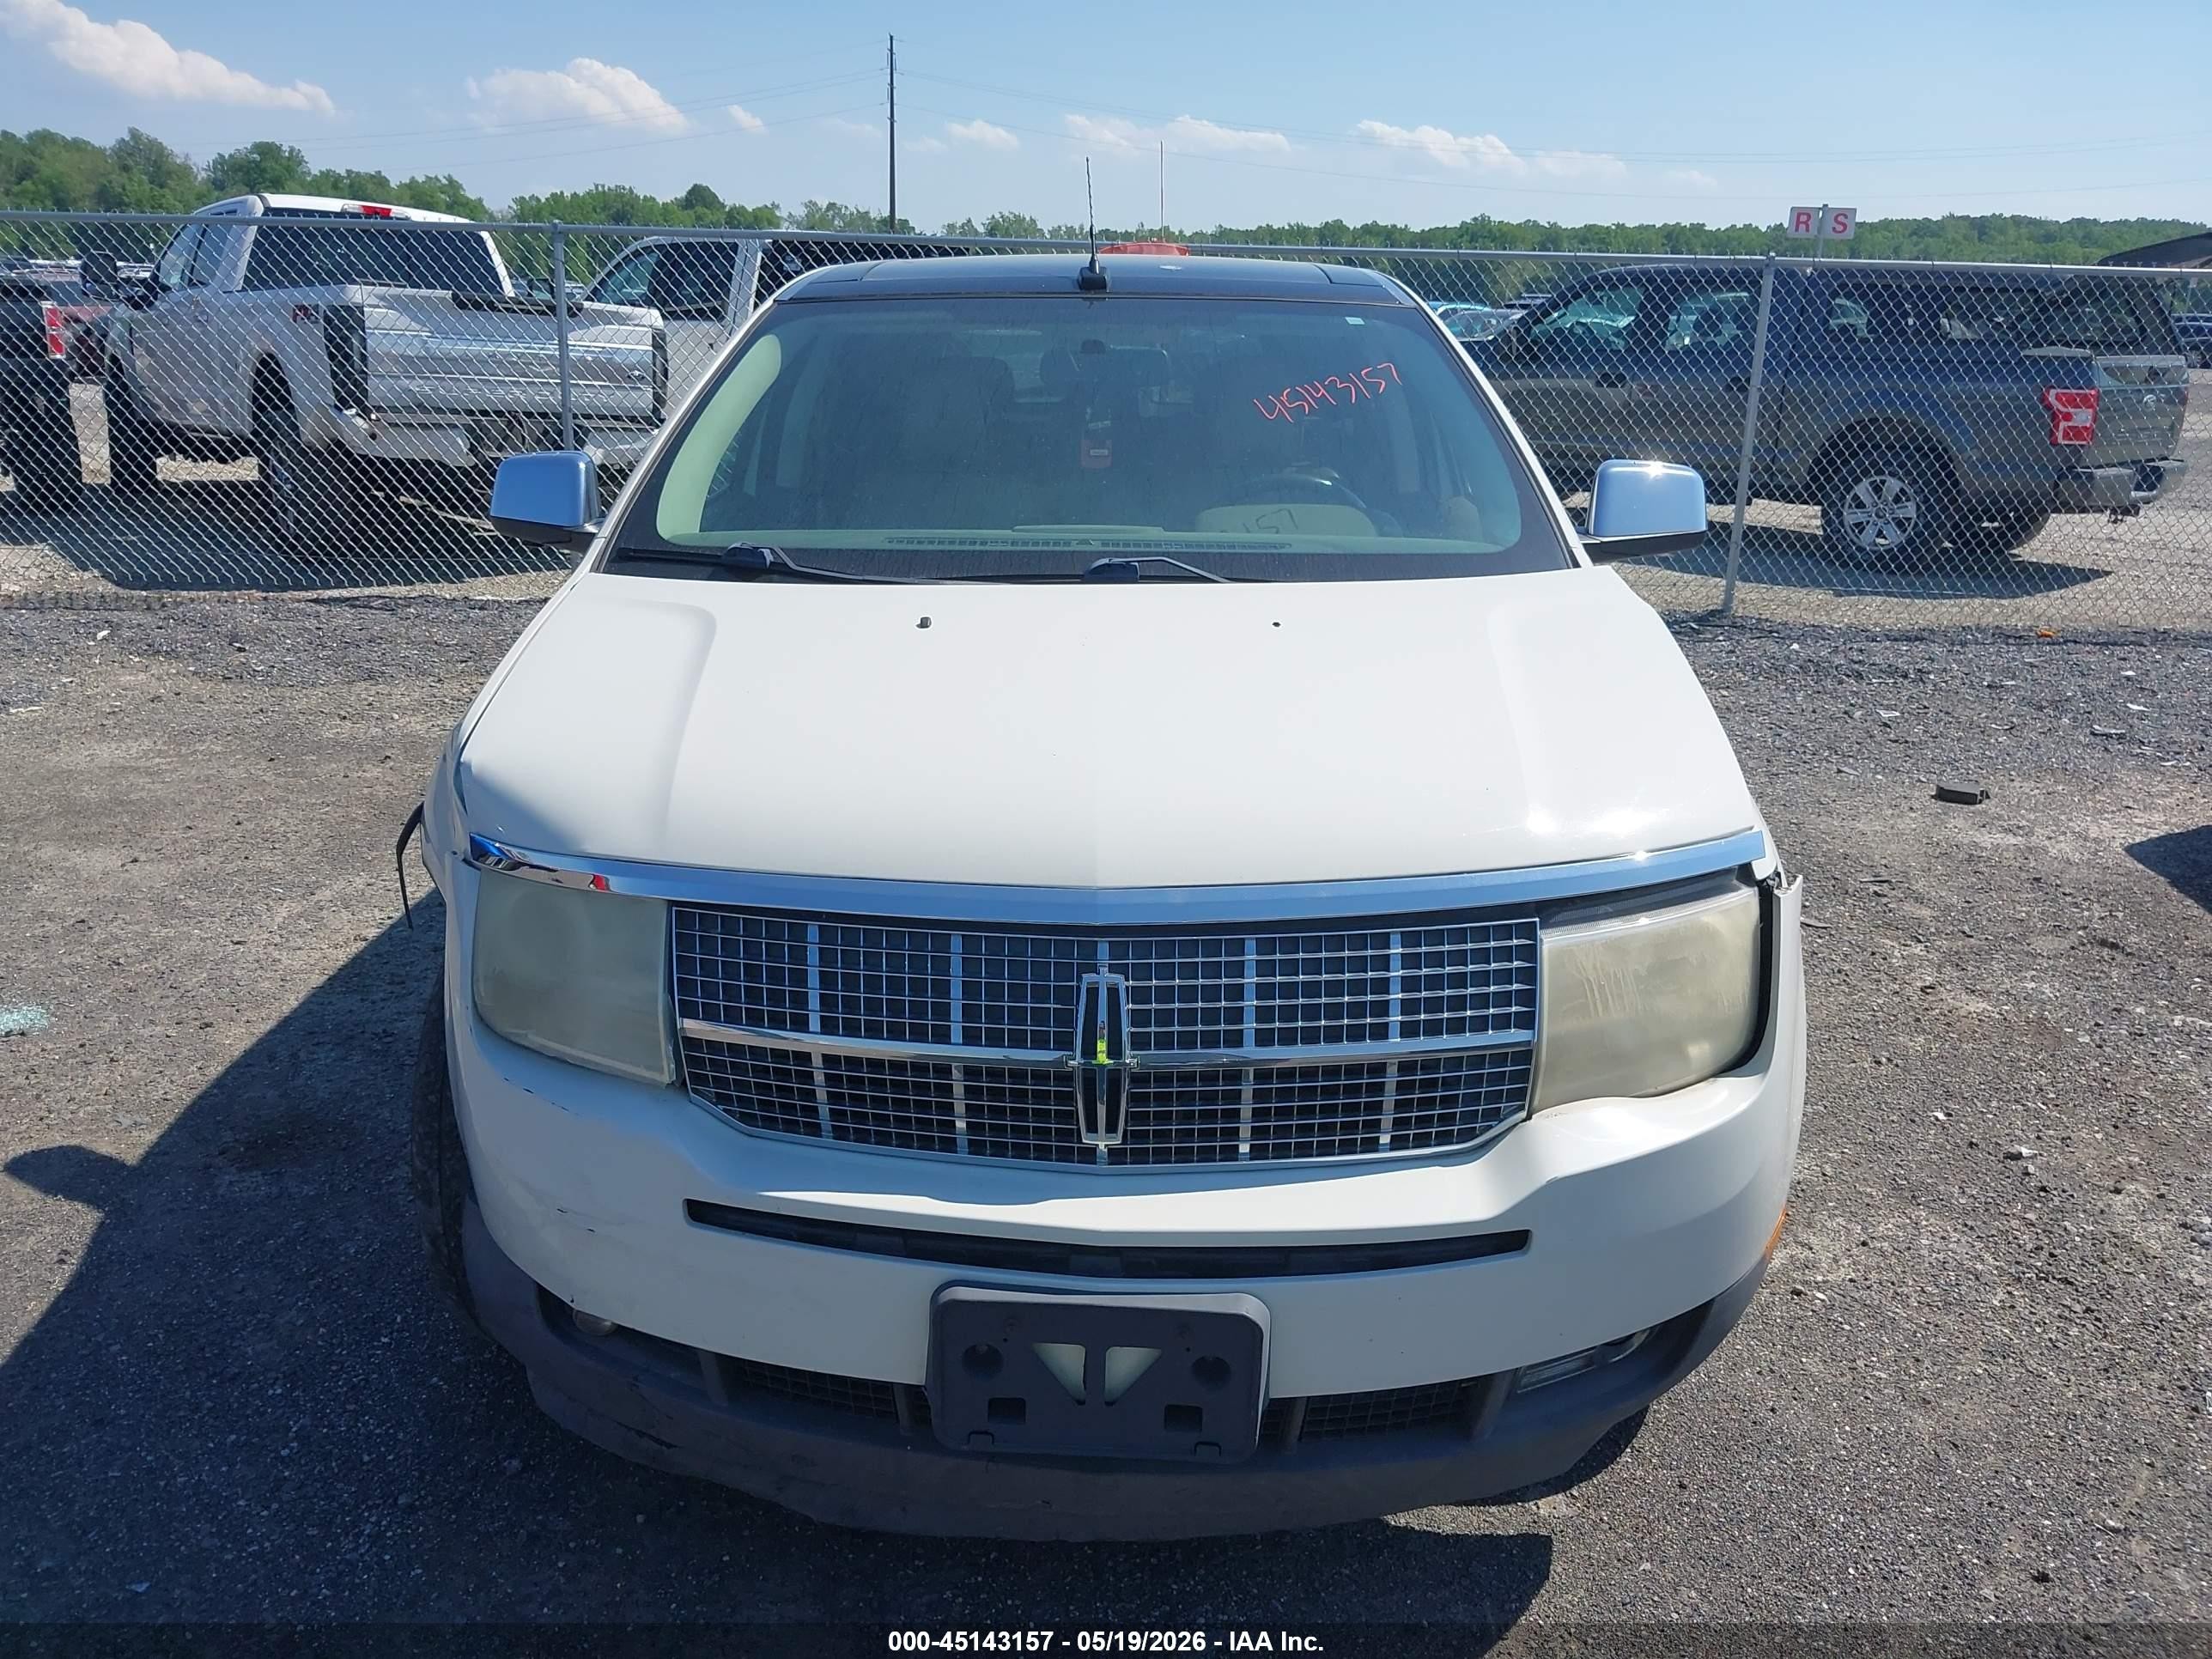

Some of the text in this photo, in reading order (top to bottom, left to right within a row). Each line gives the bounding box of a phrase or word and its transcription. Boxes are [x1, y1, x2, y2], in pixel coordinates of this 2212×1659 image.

[1794, 211, 1812, 233] R
[1832, 212, 1849, 234] S
[1253, 362, 1402, 423] 45143157
